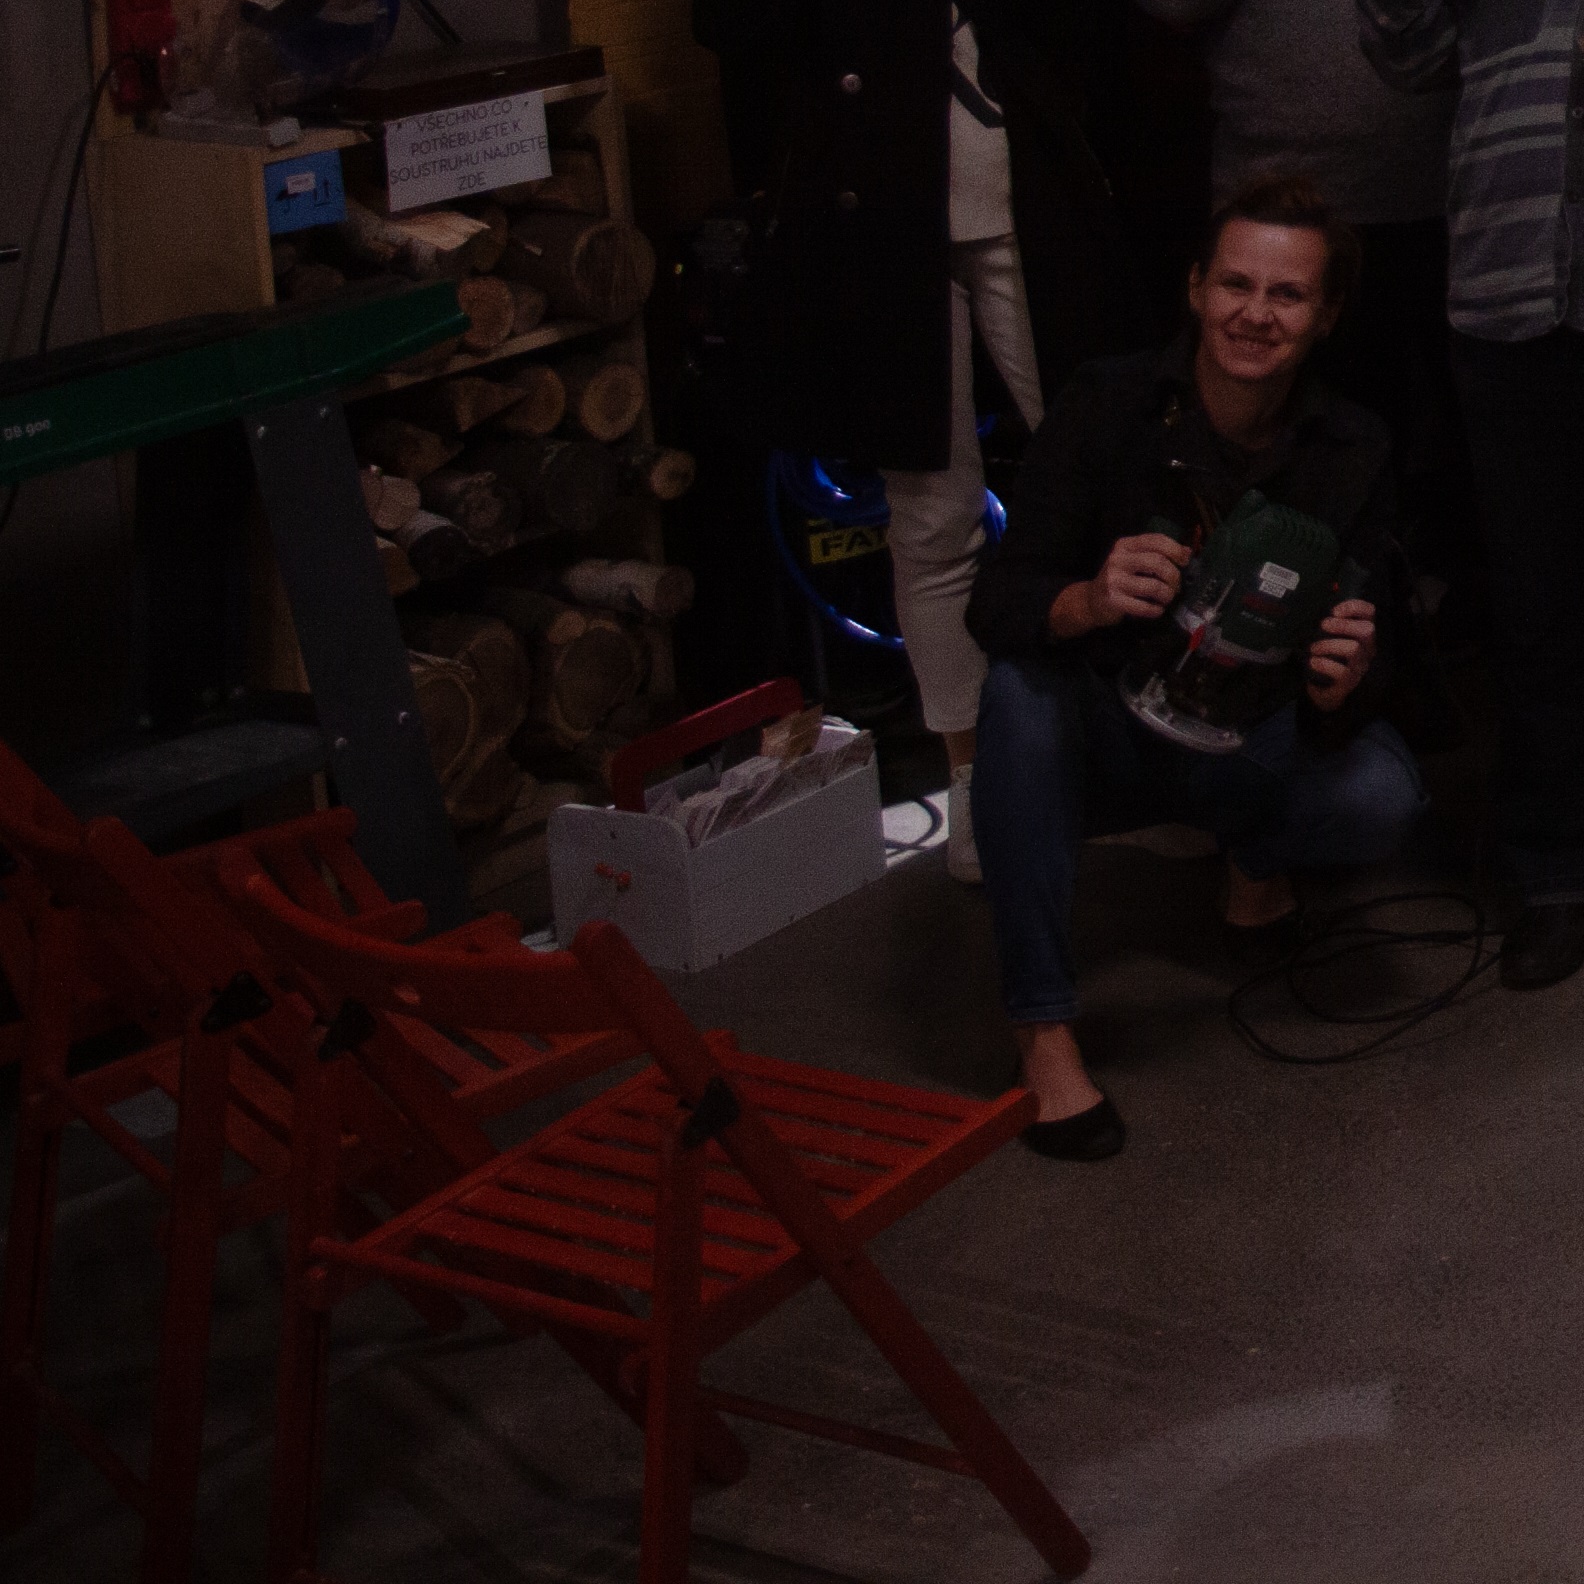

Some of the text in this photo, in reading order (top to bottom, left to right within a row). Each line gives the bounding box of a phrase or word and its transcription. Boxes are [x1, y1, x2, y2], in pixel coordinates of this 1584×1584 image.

[416, 99, 513, 133] VŠECHNO CO
[410, 120, 522, 157] POTŘEBUJETE K
[389, 134, 548, 185] SOUSTRUHU NAJDETE
[457, 171, 487, 192] ZDE
